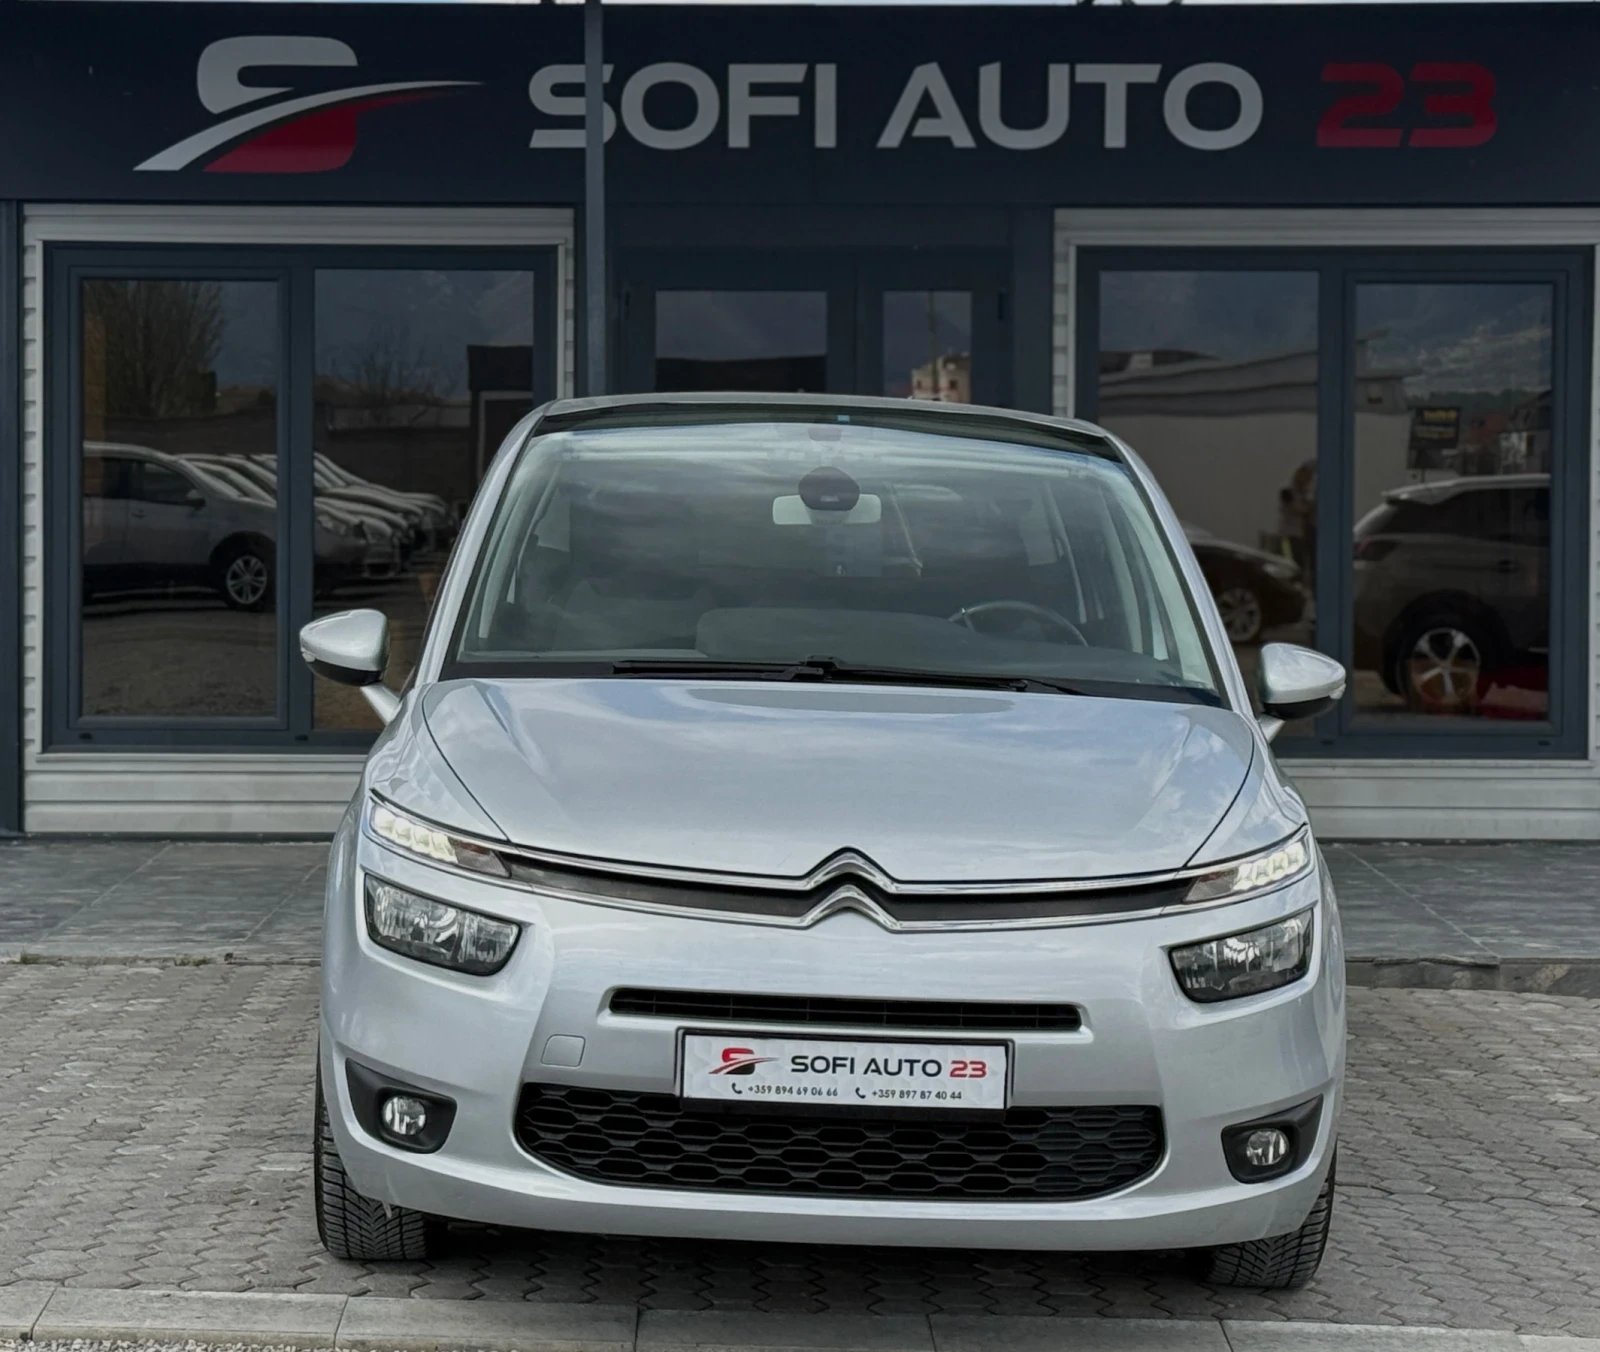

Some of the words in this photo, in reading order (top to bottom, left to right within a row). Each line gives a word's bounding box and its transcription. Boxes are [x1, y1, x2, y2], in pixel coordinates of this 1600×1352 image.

[529, 62, 837, 150] SOFI
[876, 61, 1264, 150] AUTO
[1316, 62, 1498, 148] 23
[790, 1055, 855, 1075] SOFI
[863, 1057, 942, 1078] AUTO
[949, 1060, 987, 1079] 23
[748, 1084, 772, 1094] +359
[775, 1085, 793, 1095] 894
[796, 1086, 808, 1096] 69
[811, 1086, 823, 1096] 06
[826, 1087, 838, 1097] 66
[872, 1089, 896, 1099] +359
[898, 1089, 917, 1099] 897
[920, 1090, 932, 1100] 87
[934, 1090, 947, 1100] 40
[949, 1090, 962, 1100] 44
